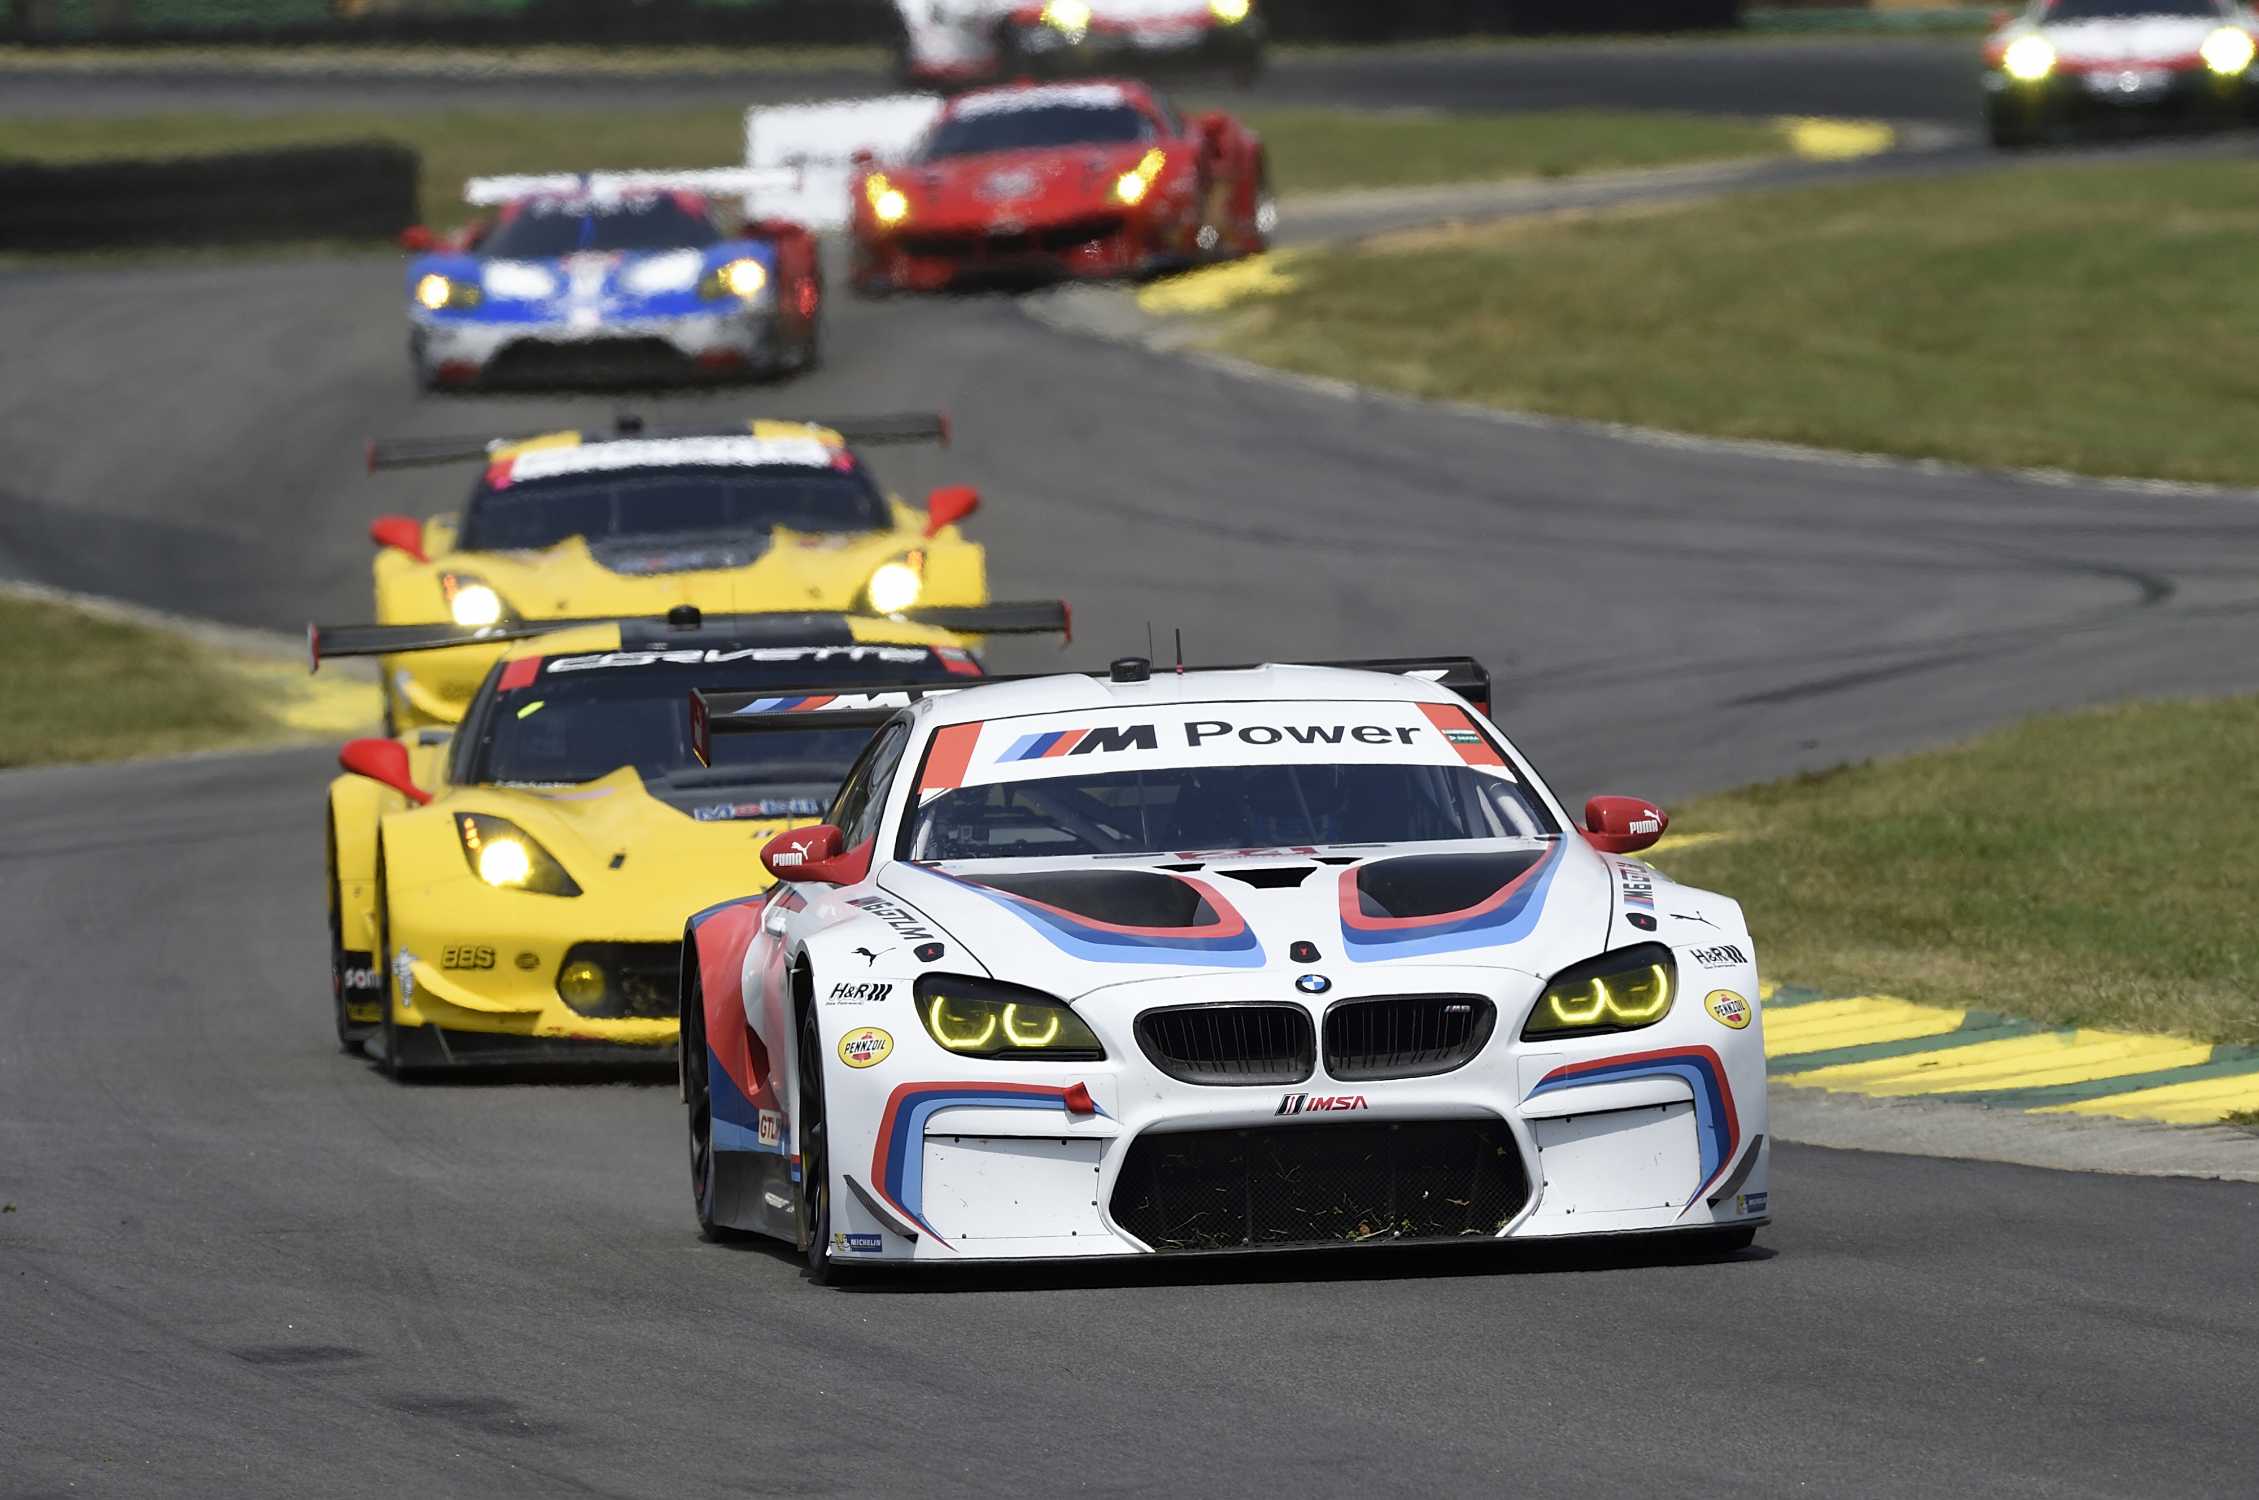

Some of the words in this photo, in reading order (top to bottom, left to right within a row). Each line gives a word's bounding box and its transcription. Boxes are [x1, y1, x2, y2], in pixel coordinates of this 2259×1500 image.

[1184, 721, 1421, 748] Power
[1629, 820, 1659, 835] PUMA
[772, 852, 803, 867] PUMA
[442, 945, 496, 971] BBS
[830, 982, 870, 999] H&R
[844, 1038, 887, 1056] PENNZOIL
[1306, 1095, 1369, 1112] IMSA
[850, 1238, 881, 1247] MICHELIN
